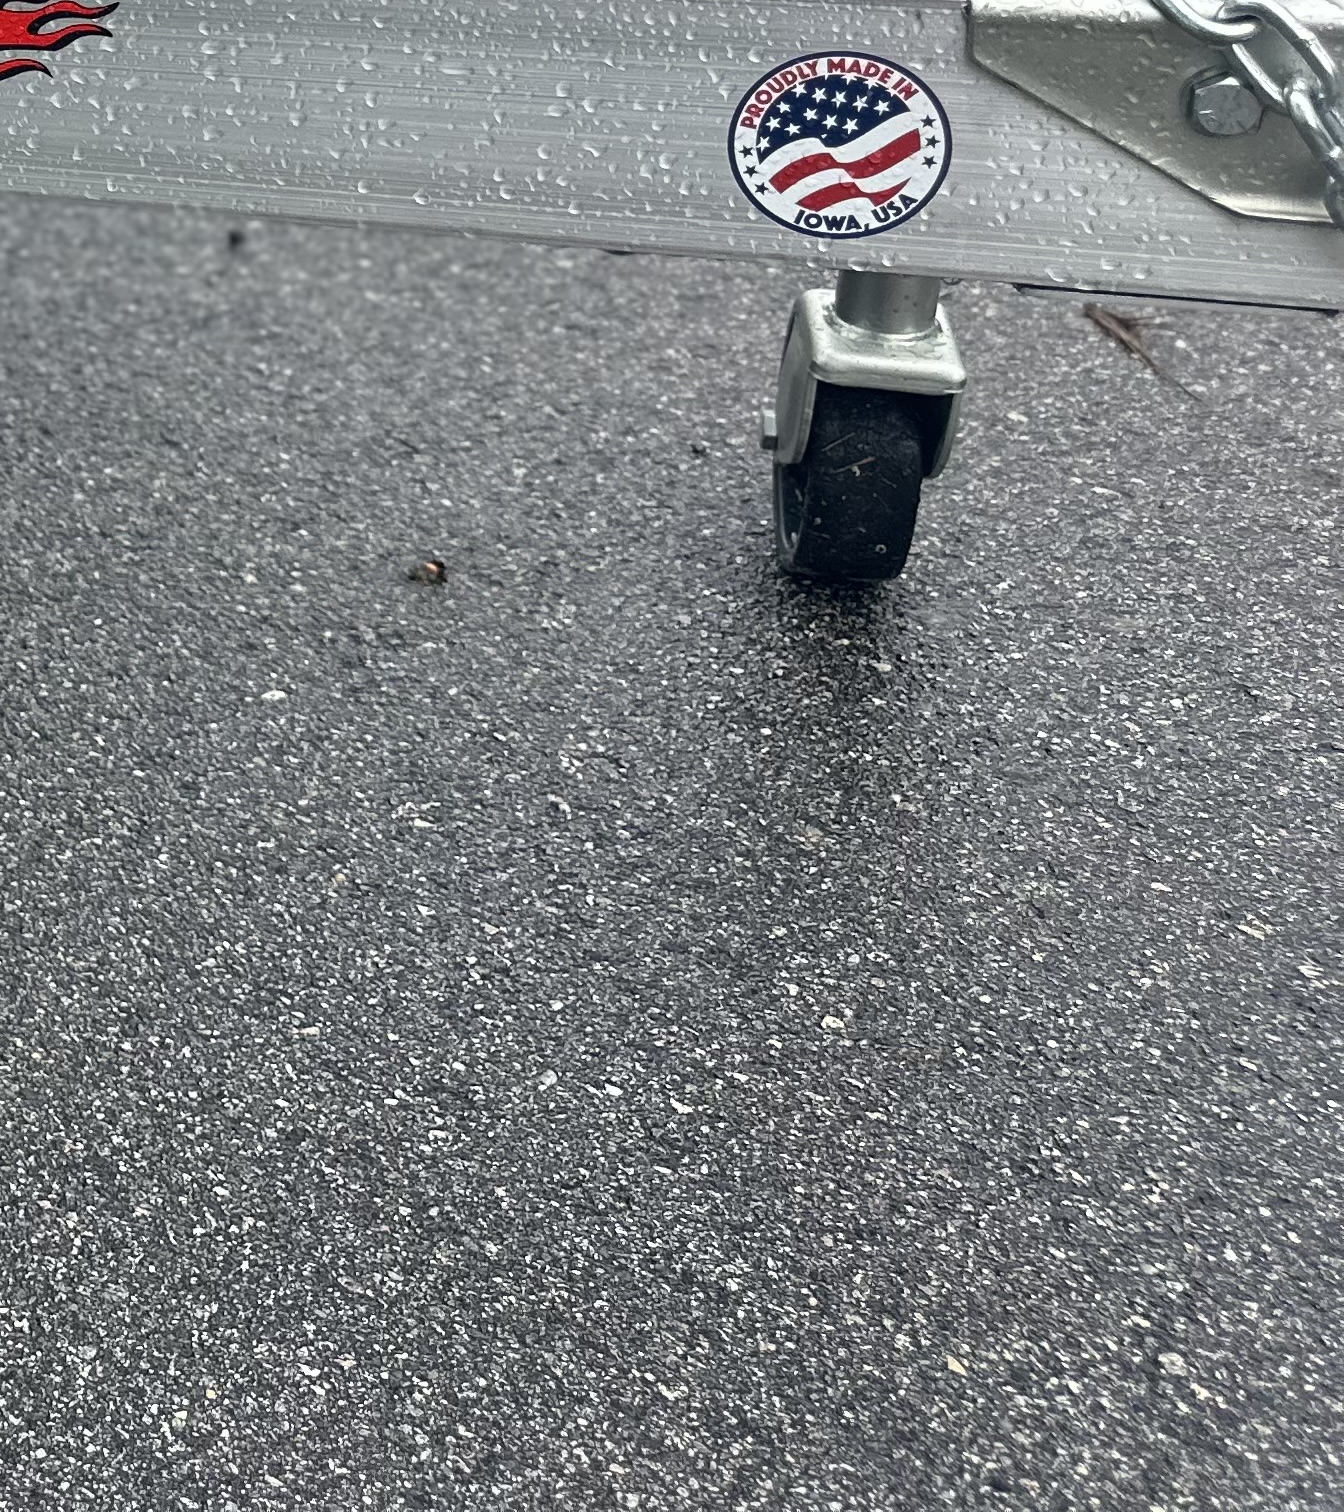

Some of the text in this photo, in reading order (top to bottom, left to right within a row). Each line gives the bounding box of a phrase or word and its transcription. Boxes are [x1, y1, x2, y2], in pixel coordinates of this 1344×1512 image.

[740, 57, 920, 130] PROUDLY MADE IN
[871, 193, 919, 224] USA
